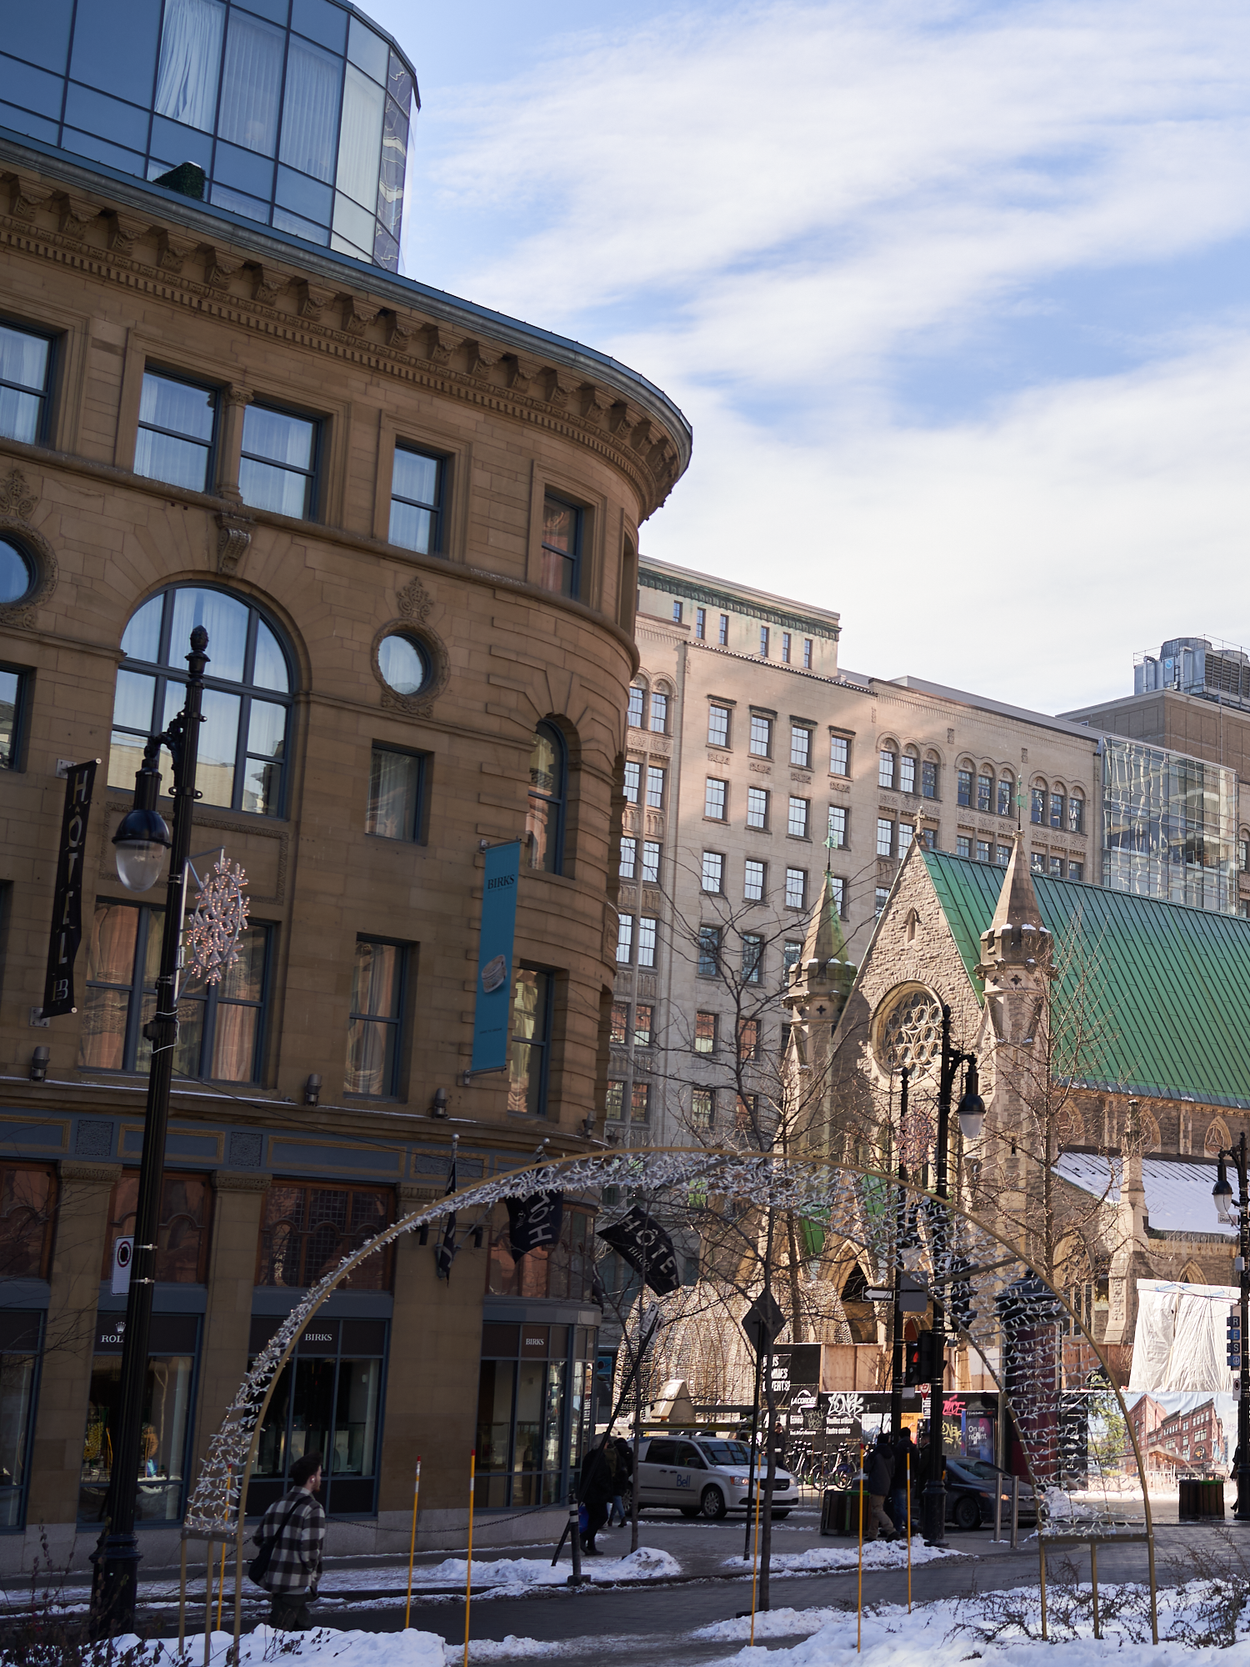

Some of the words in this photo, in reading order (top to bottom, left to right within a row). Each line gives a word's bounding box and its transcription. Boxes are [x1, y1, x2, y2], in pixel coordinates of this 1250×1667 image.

[487, 874, 515, 889] BIRKS
[305, 1333, 333, 1341] BIRKS
[525, 1338, 545, 1346] BIRKS
[676, 1474, 691, 1488] Bell
